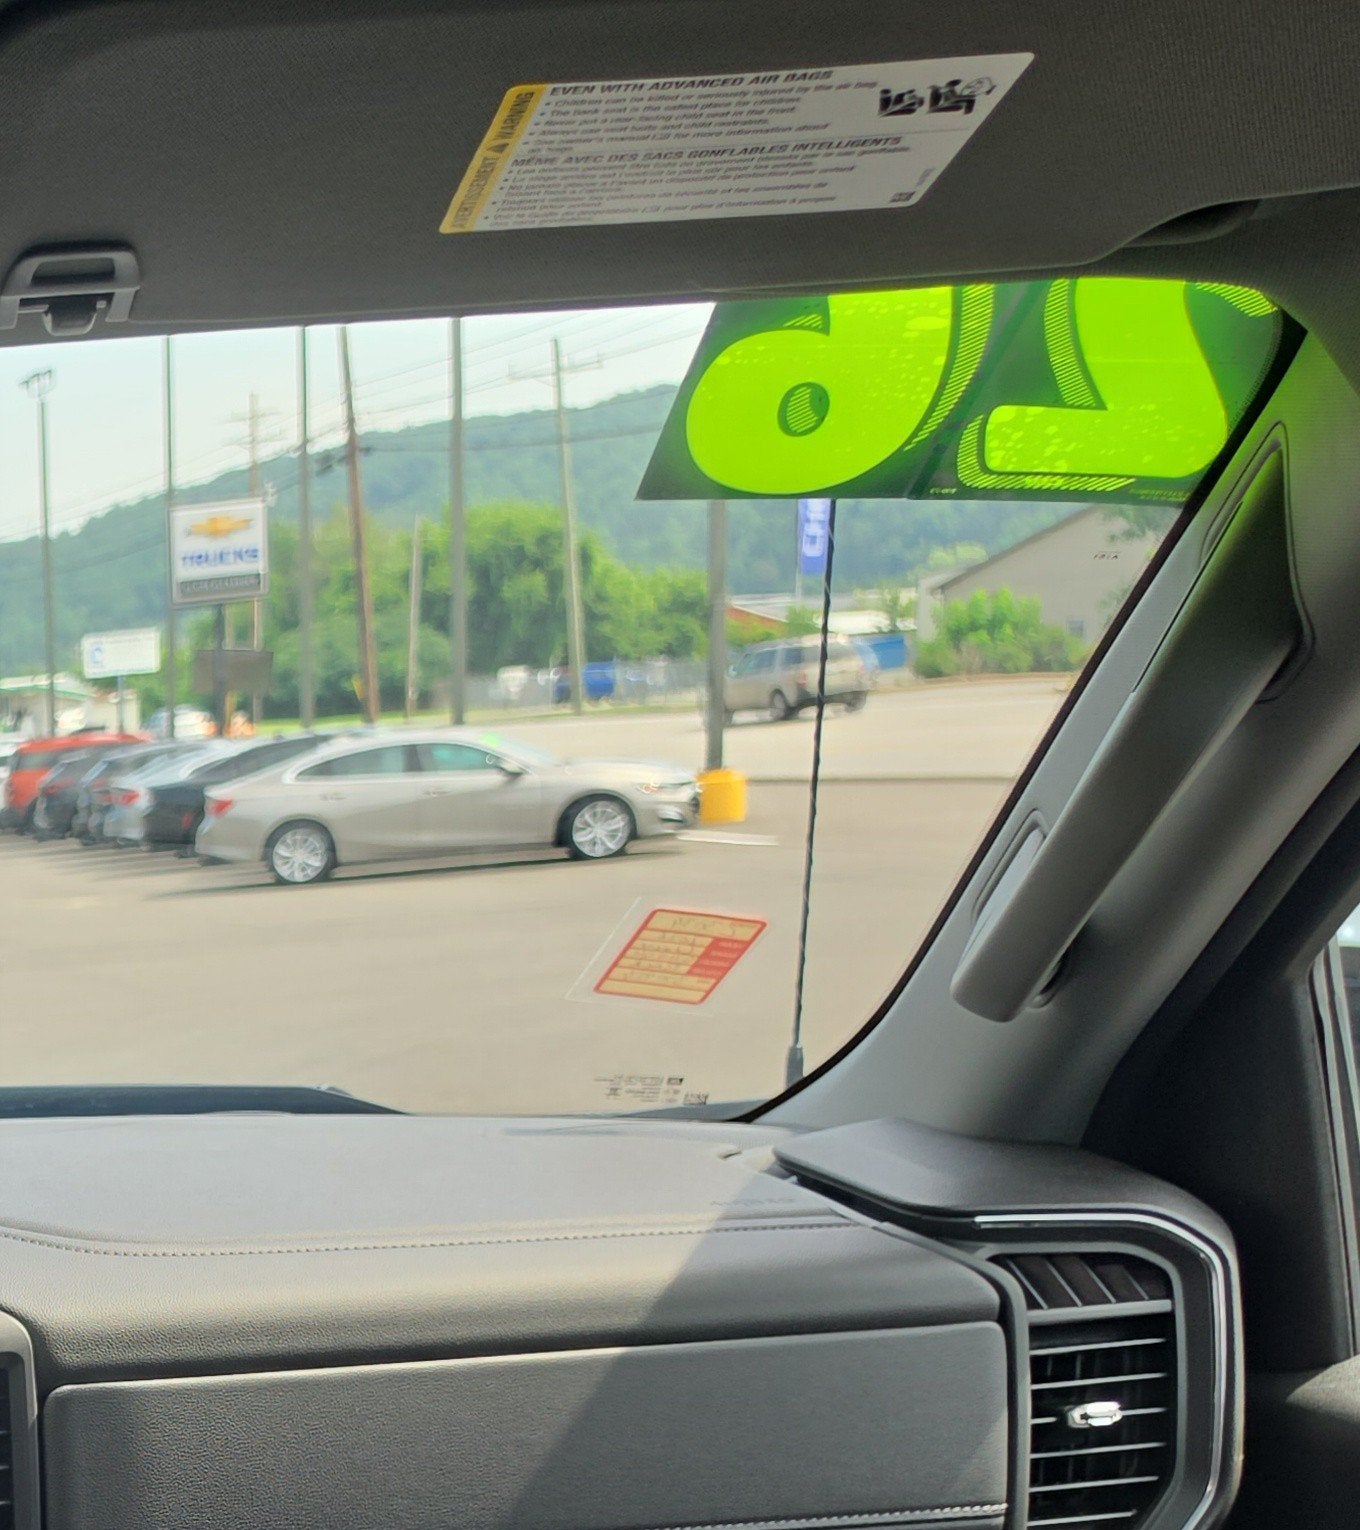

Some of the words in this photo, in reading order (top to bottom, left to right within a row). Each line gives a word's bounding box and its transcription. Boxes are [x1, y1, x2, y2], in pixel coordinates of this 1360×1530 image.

[550, 84, 596, 96] EVEN
[600, 82, 645, 94] WITH
[648, 77, 745, 91] ADVANCED
[748, 74, 781, 86] AIR
[782, 70, 834, 83] BAGS
[563, 154, 605, 165] AVEC
[606, 152, 639, 163] DES
[642, 150, 685, 161] SACS
[791, 136, 903, 151] INTELLIGENTS
